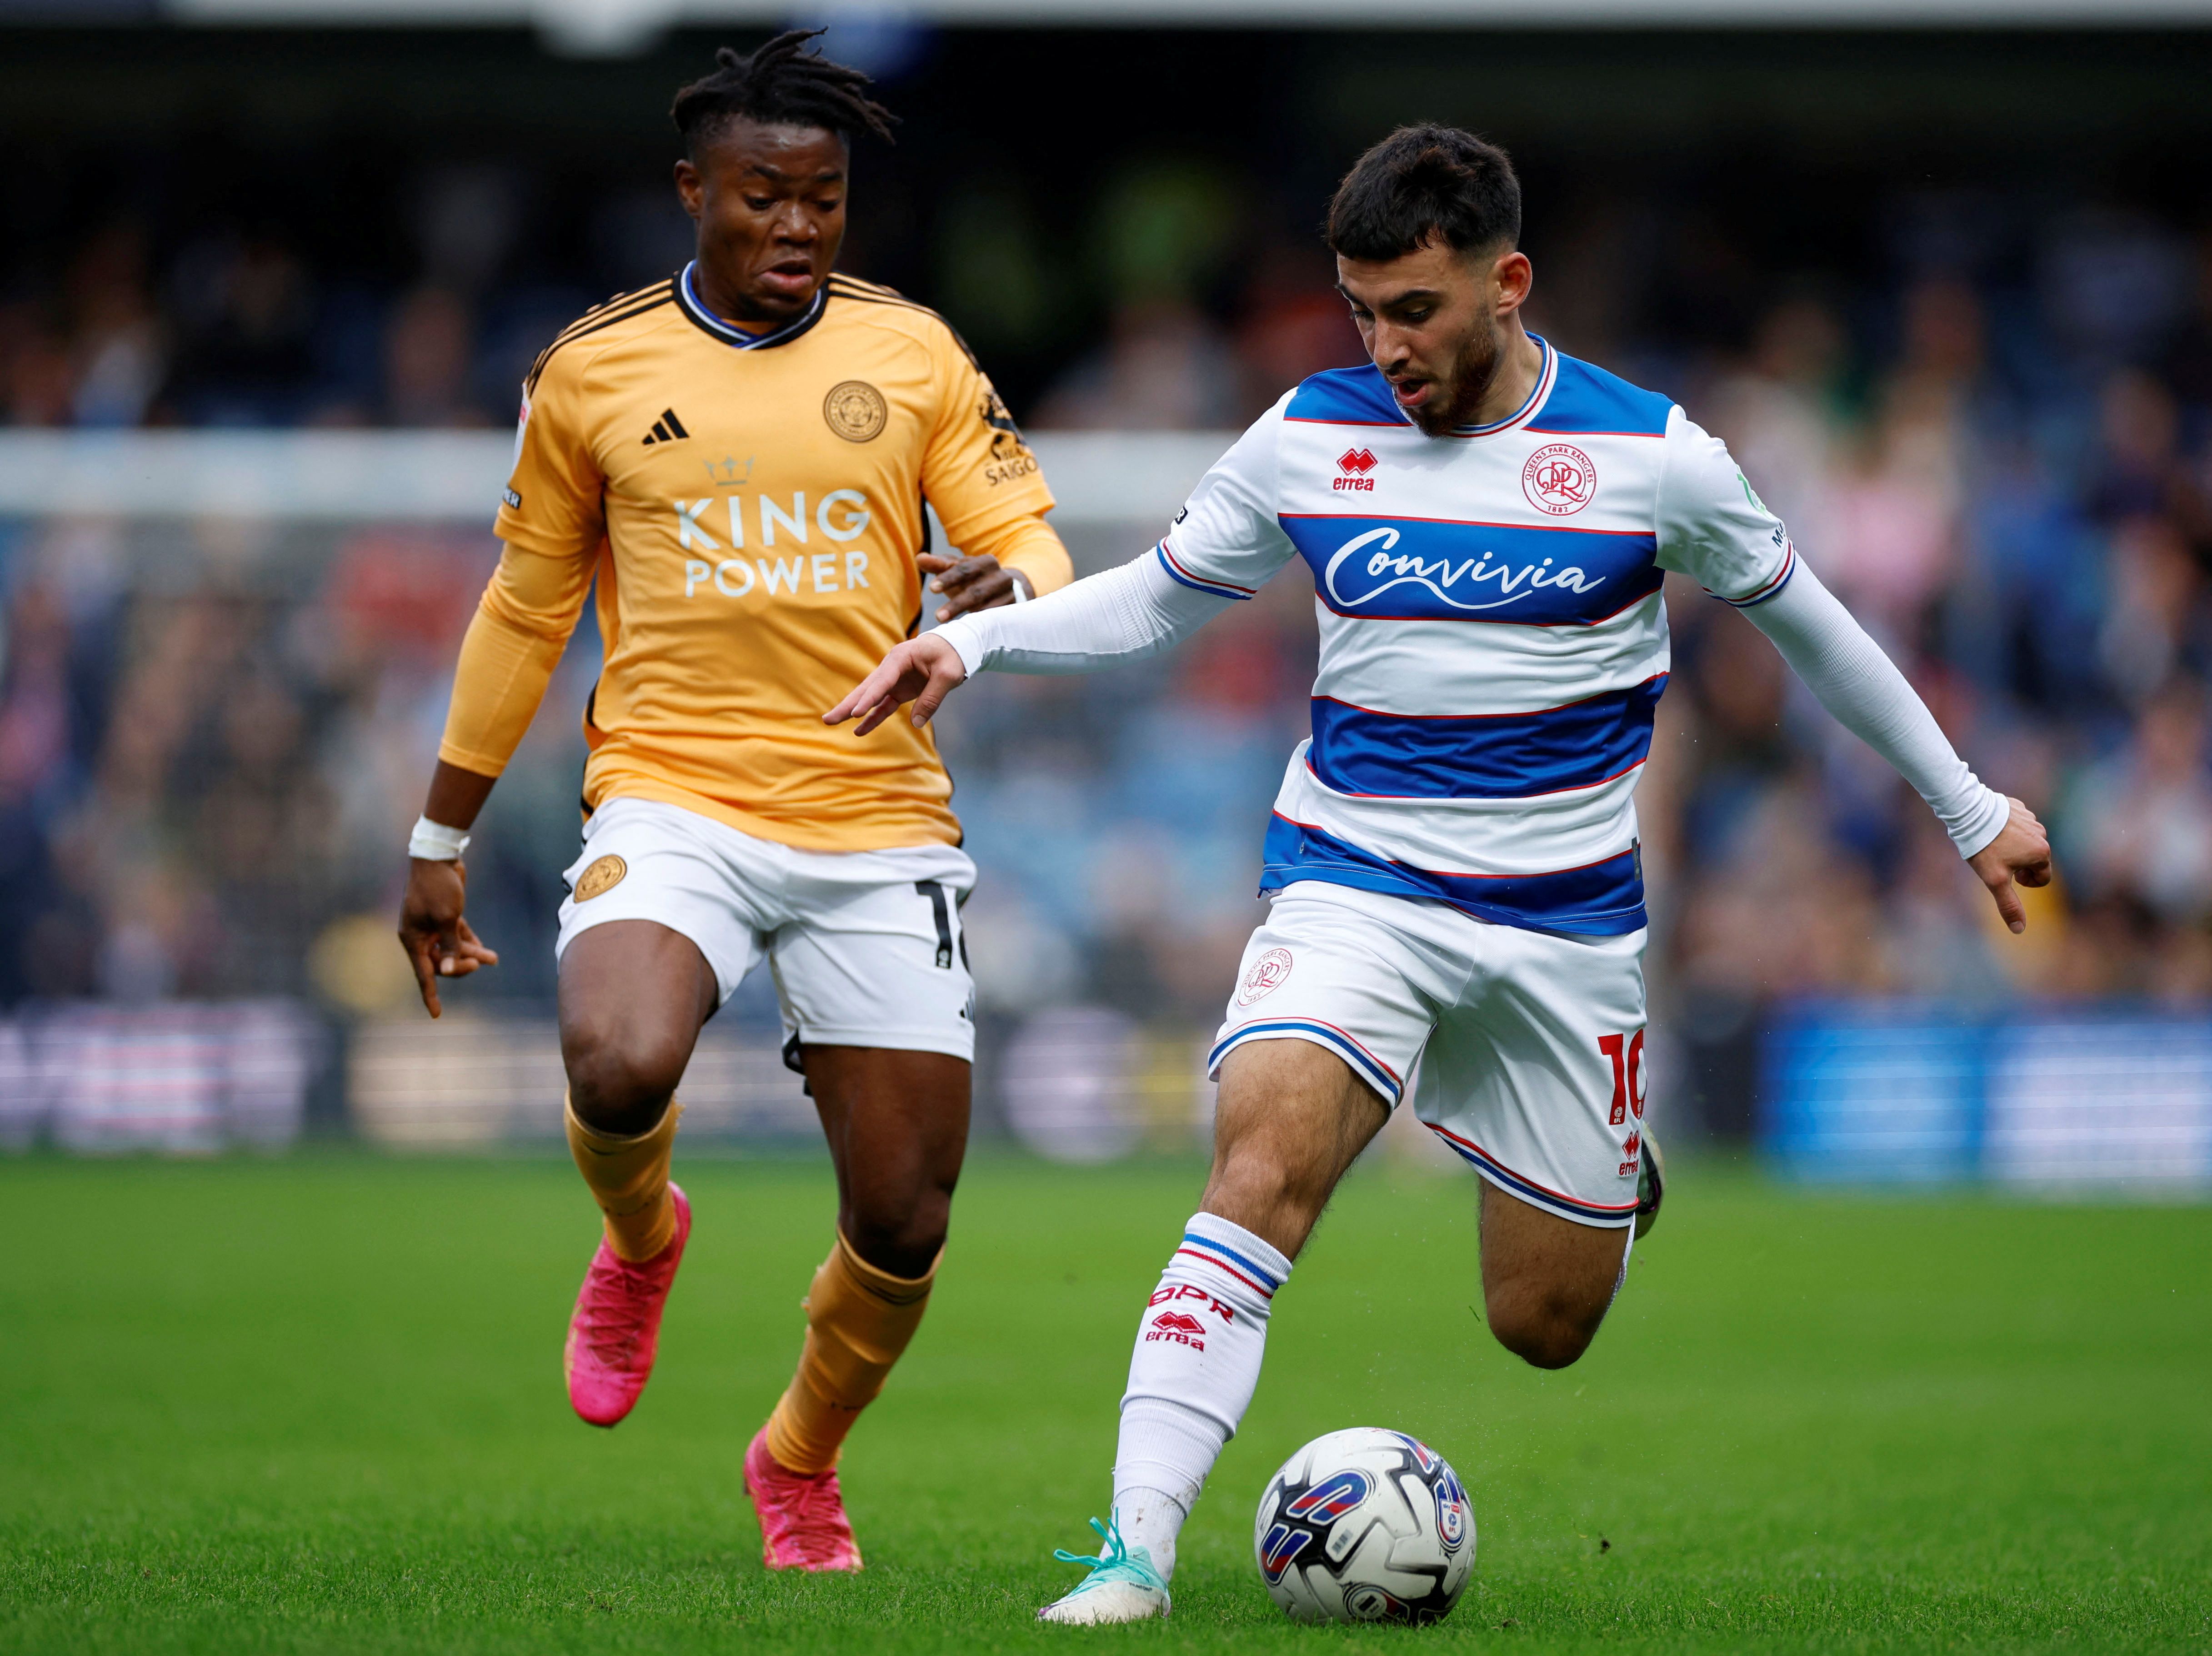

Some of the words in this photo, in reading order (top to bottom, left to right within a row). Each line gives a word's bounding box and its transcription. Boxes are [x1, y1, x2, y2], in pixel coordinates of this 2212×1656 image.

[1333, 477, 1374, 491] errea
[1525, 451, 1546, 480] QUEENS
[1571, 450, 1593, 483] RANGERS
[674, 489, 871, 550] KING
[685, 551, 870, 597] POWER
[1325, 527, 1606, 609] Convivia
[915, 879, 971, 974] 1
[1597, 1028, 1647, 1125] 10
[1146, 1331, 1205, 1352] errea
